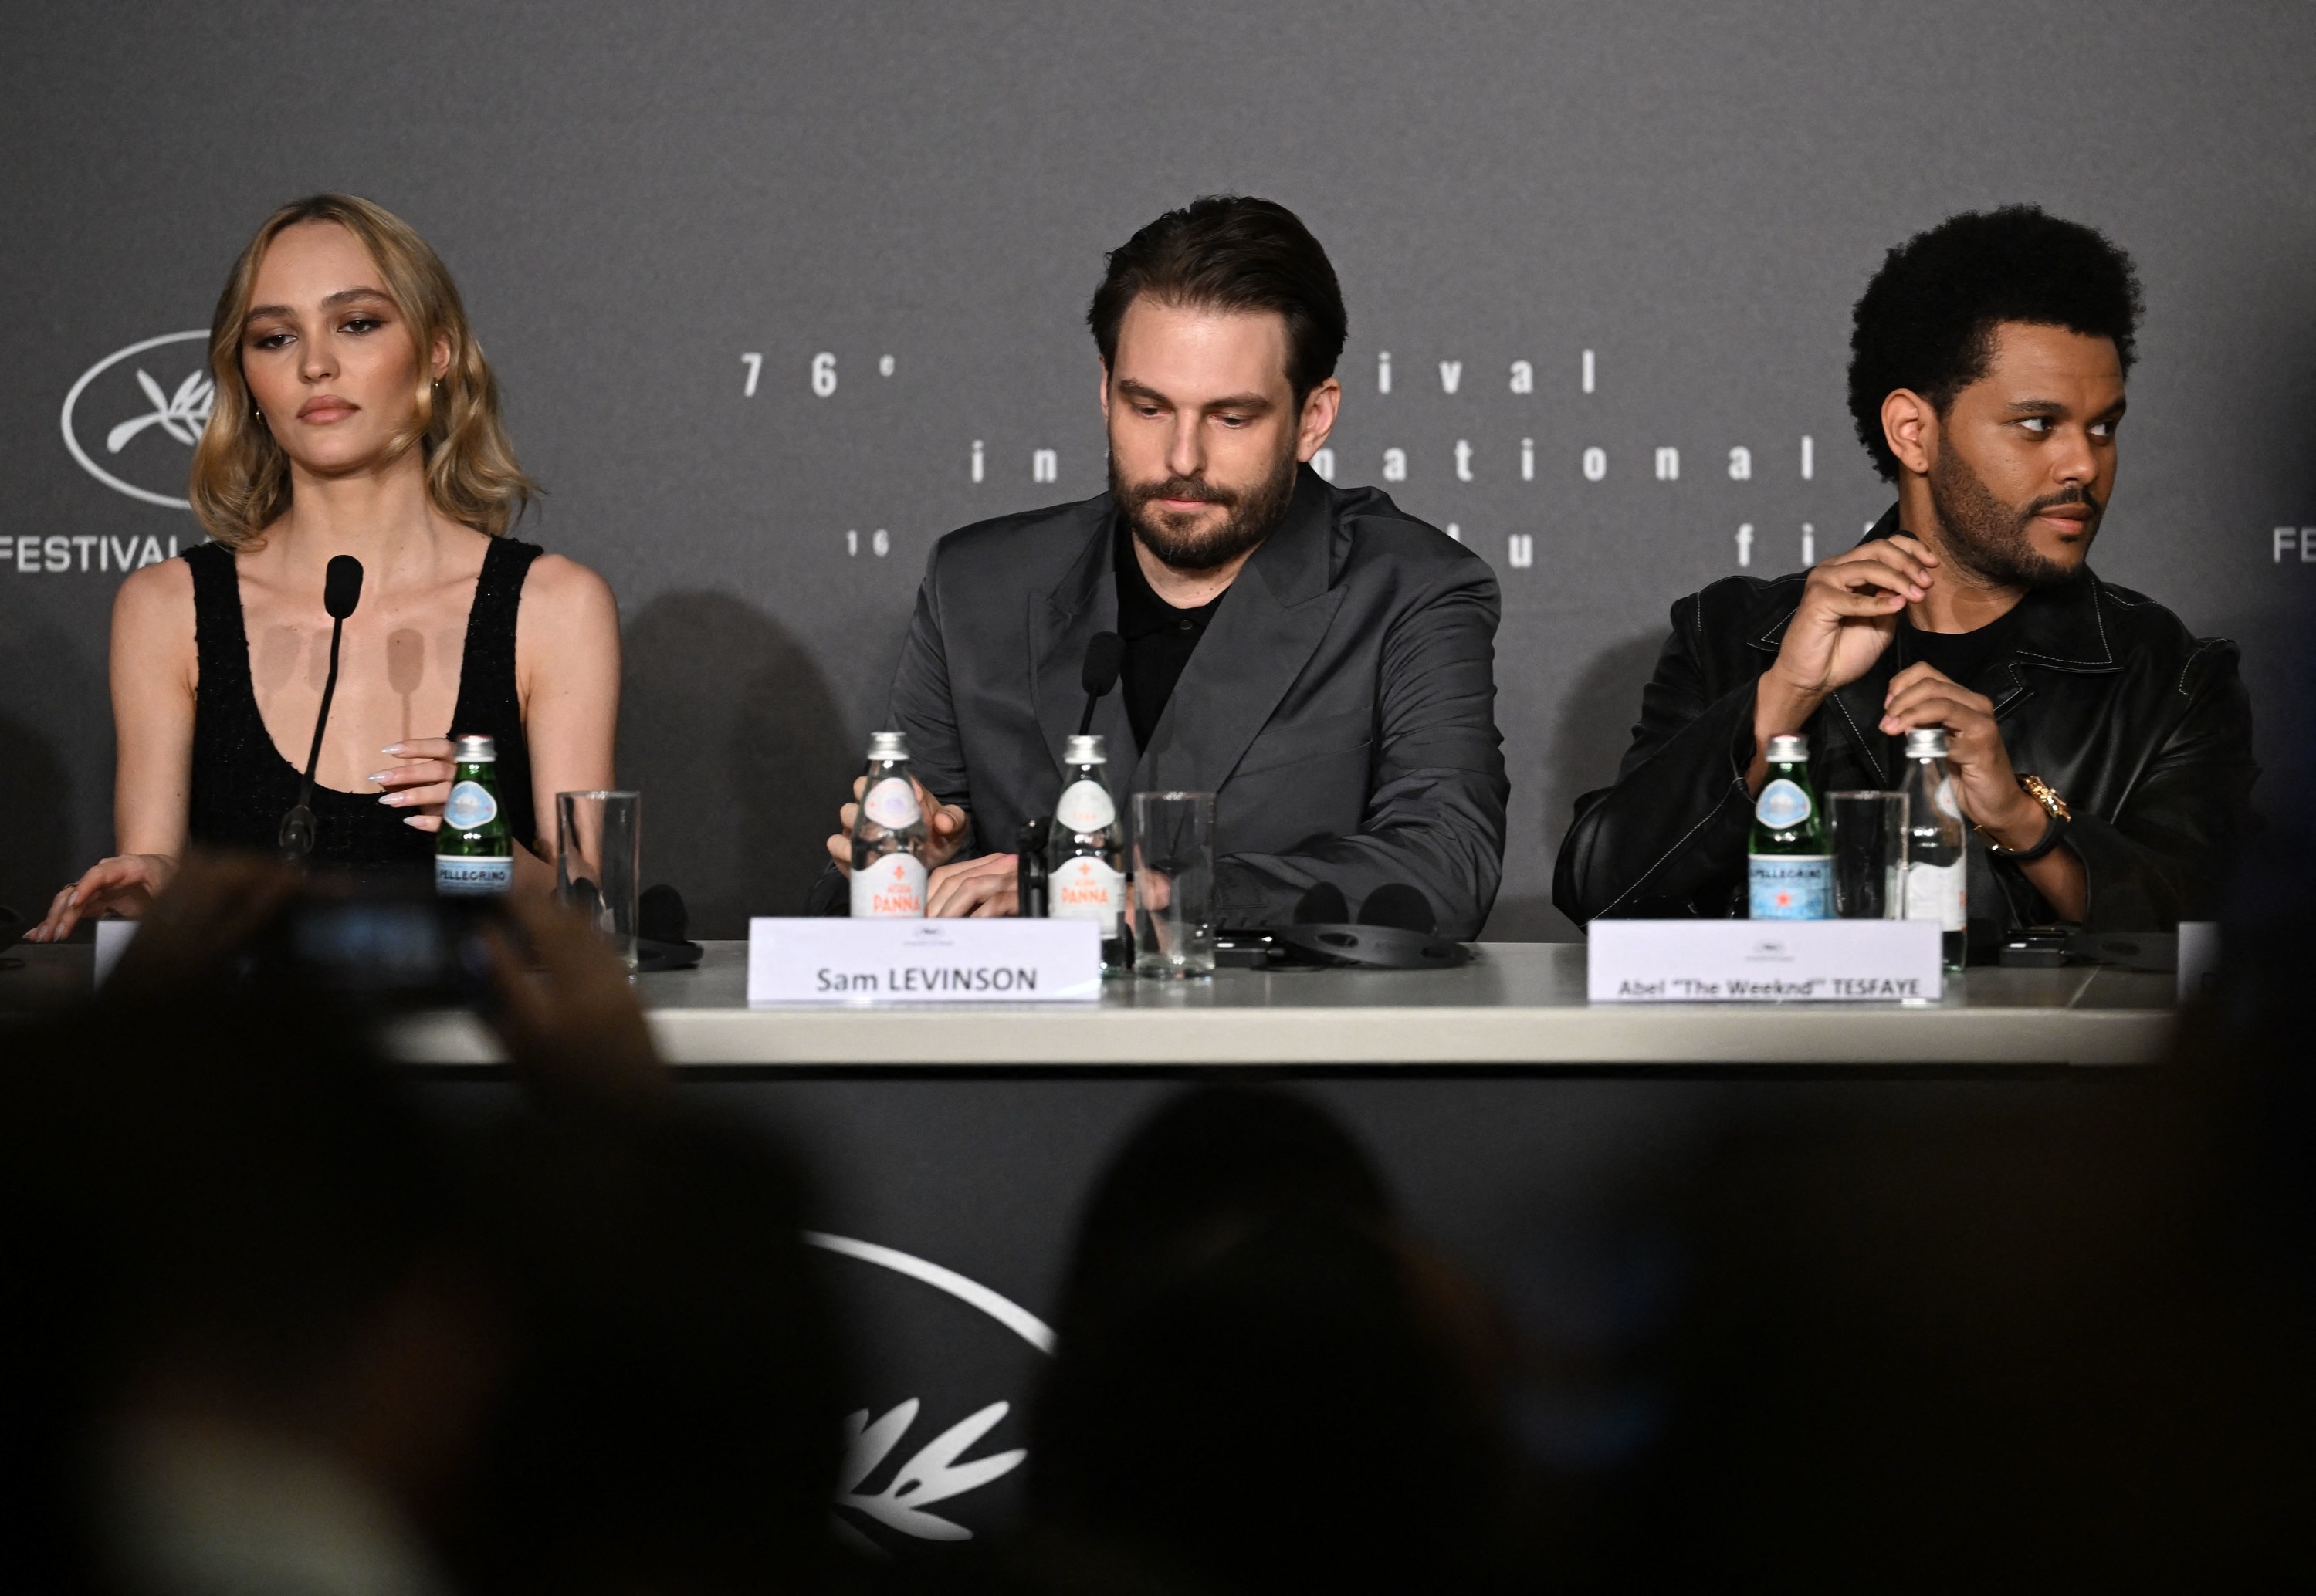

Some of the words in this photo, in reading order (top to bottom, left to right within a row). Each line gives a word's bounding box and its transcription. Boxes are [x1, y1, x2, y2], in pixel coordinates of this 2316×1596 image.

[1378, 349, 1596, 394] ival
[847, 529, 889, 556] 16
[873, 894, 920, 913] PANNA
[1062, 888, 1108, 904] PANNA
[817, 968, 878, 992] Sam
[889, 968, 1037, 991] LEVINSON
[1619, 978, 1665, 995] Abel
[1834, 978, 1919, 995] TESFAYE
